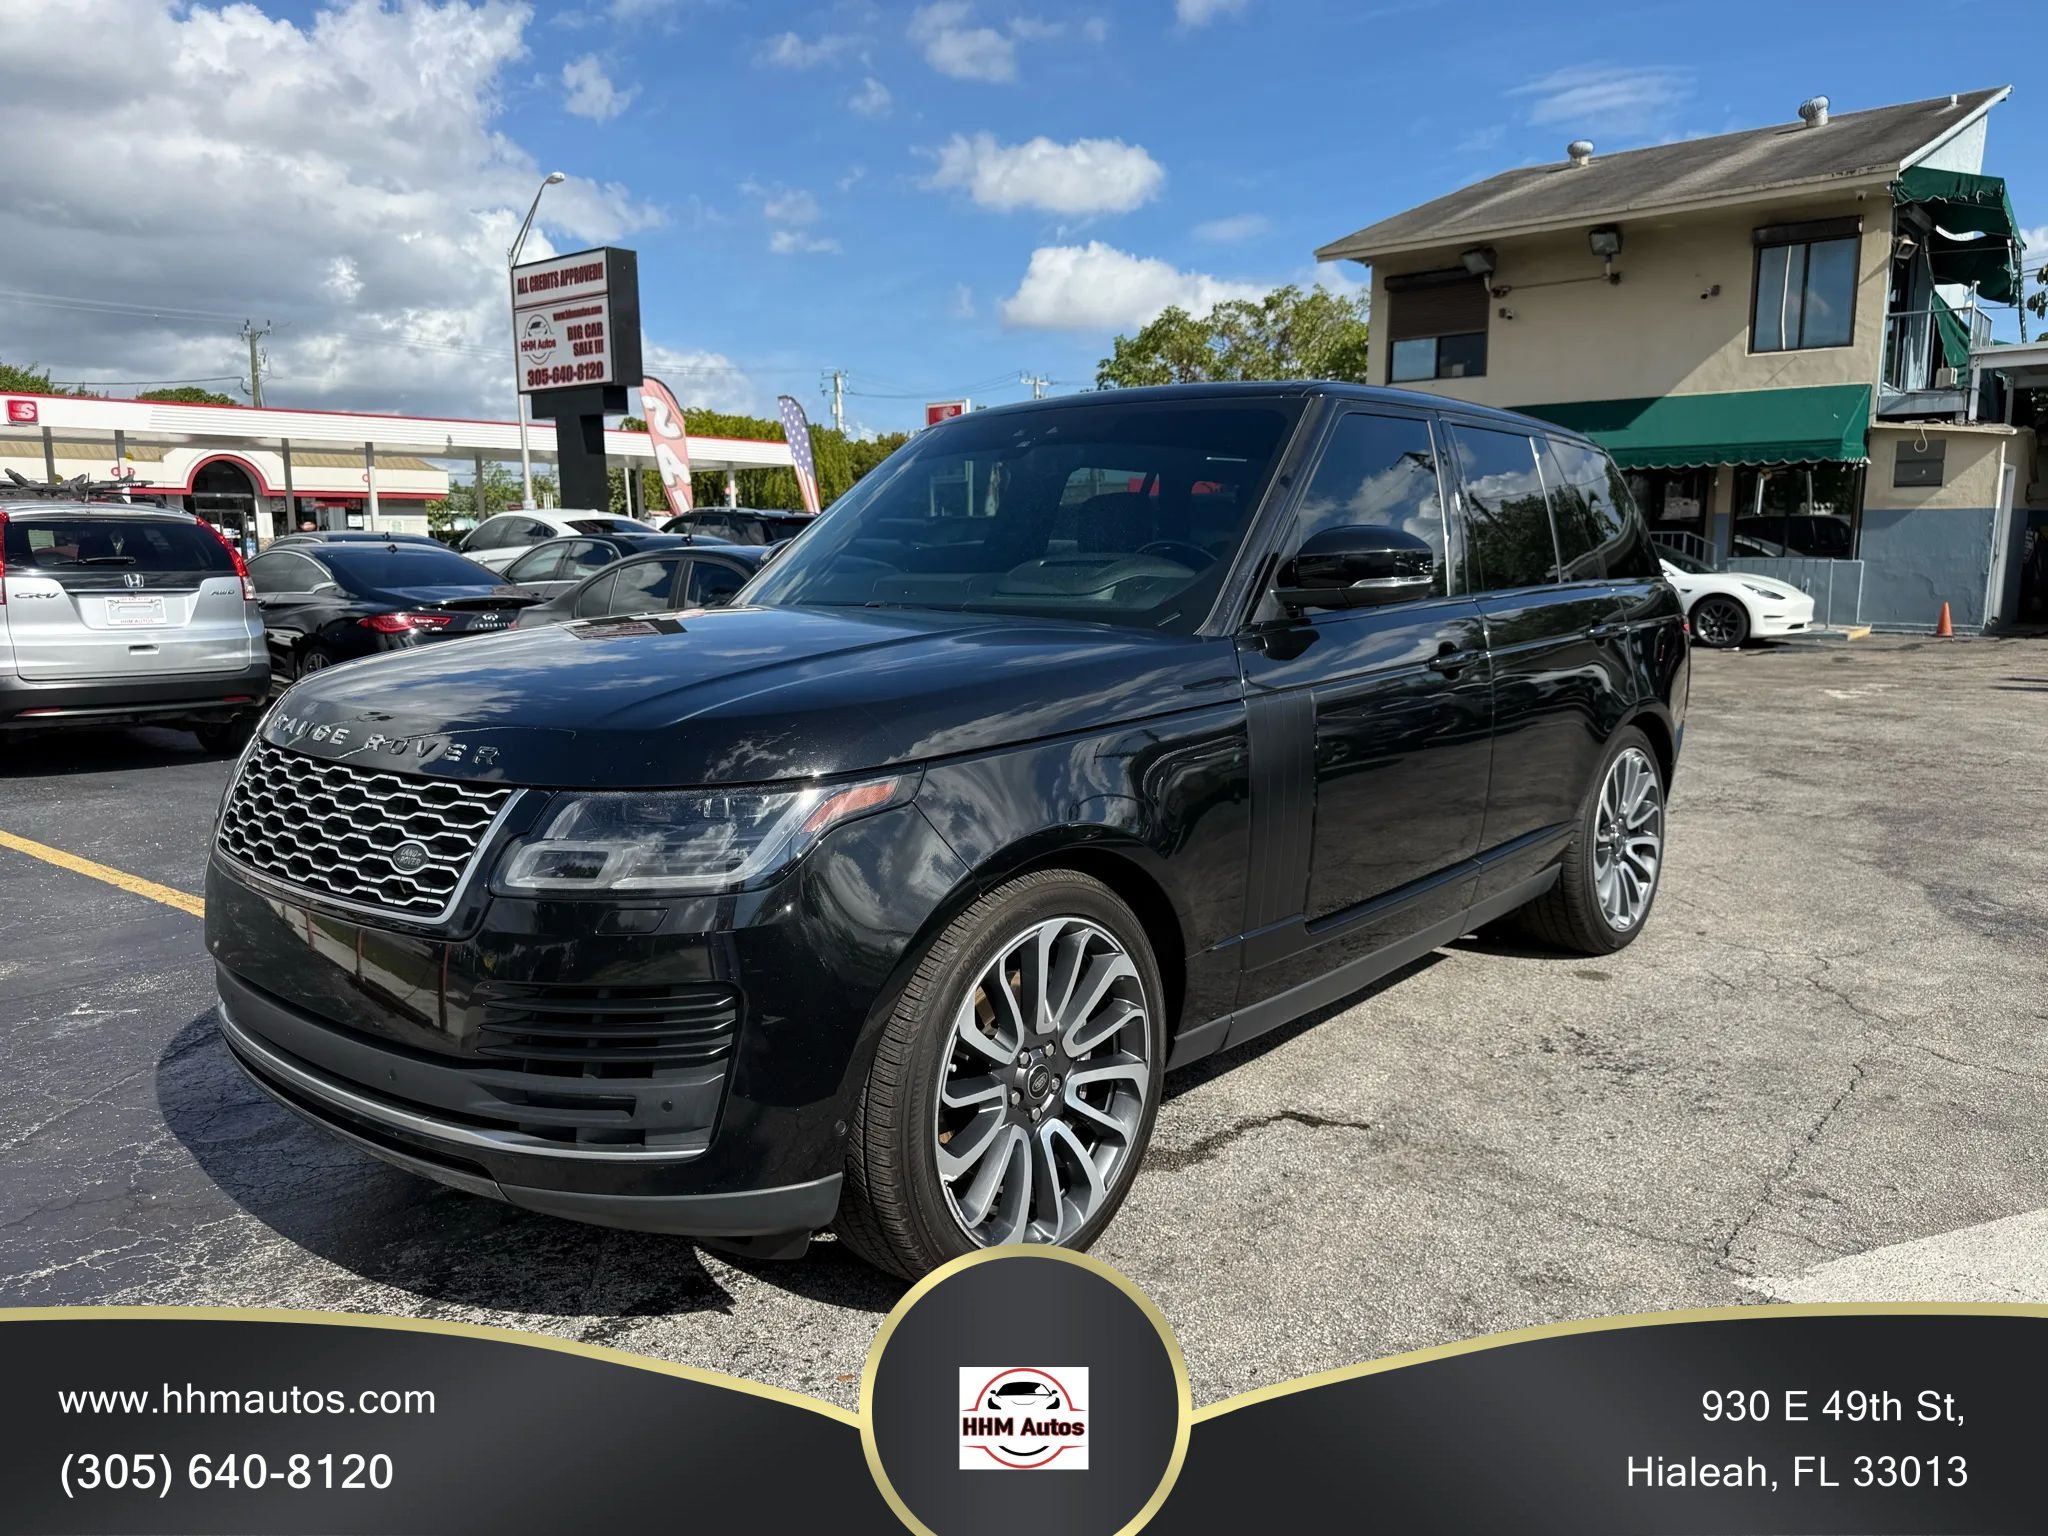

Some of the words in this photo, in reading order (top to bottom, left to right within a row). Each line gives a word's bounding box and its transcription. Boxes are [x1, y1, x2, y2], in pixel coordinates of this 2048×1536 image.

[517, 276, 529, 295] ALL
[529, 270, 559, 293] CREDITS
[567, 325, 583, 341] BIG
[585, 321, 603, 338] CAR
[537, 338, 556, 349] Autos
[573, 341, 593, 357] SALE
[527, 360, 604, 387] 305-640-8120
[273, 713, 350, 745] RANGE
[364, 733, 500, 766] ROVER
[400, 848, 419, 857] LAND
[400, 856, 421, 866] ROVER
